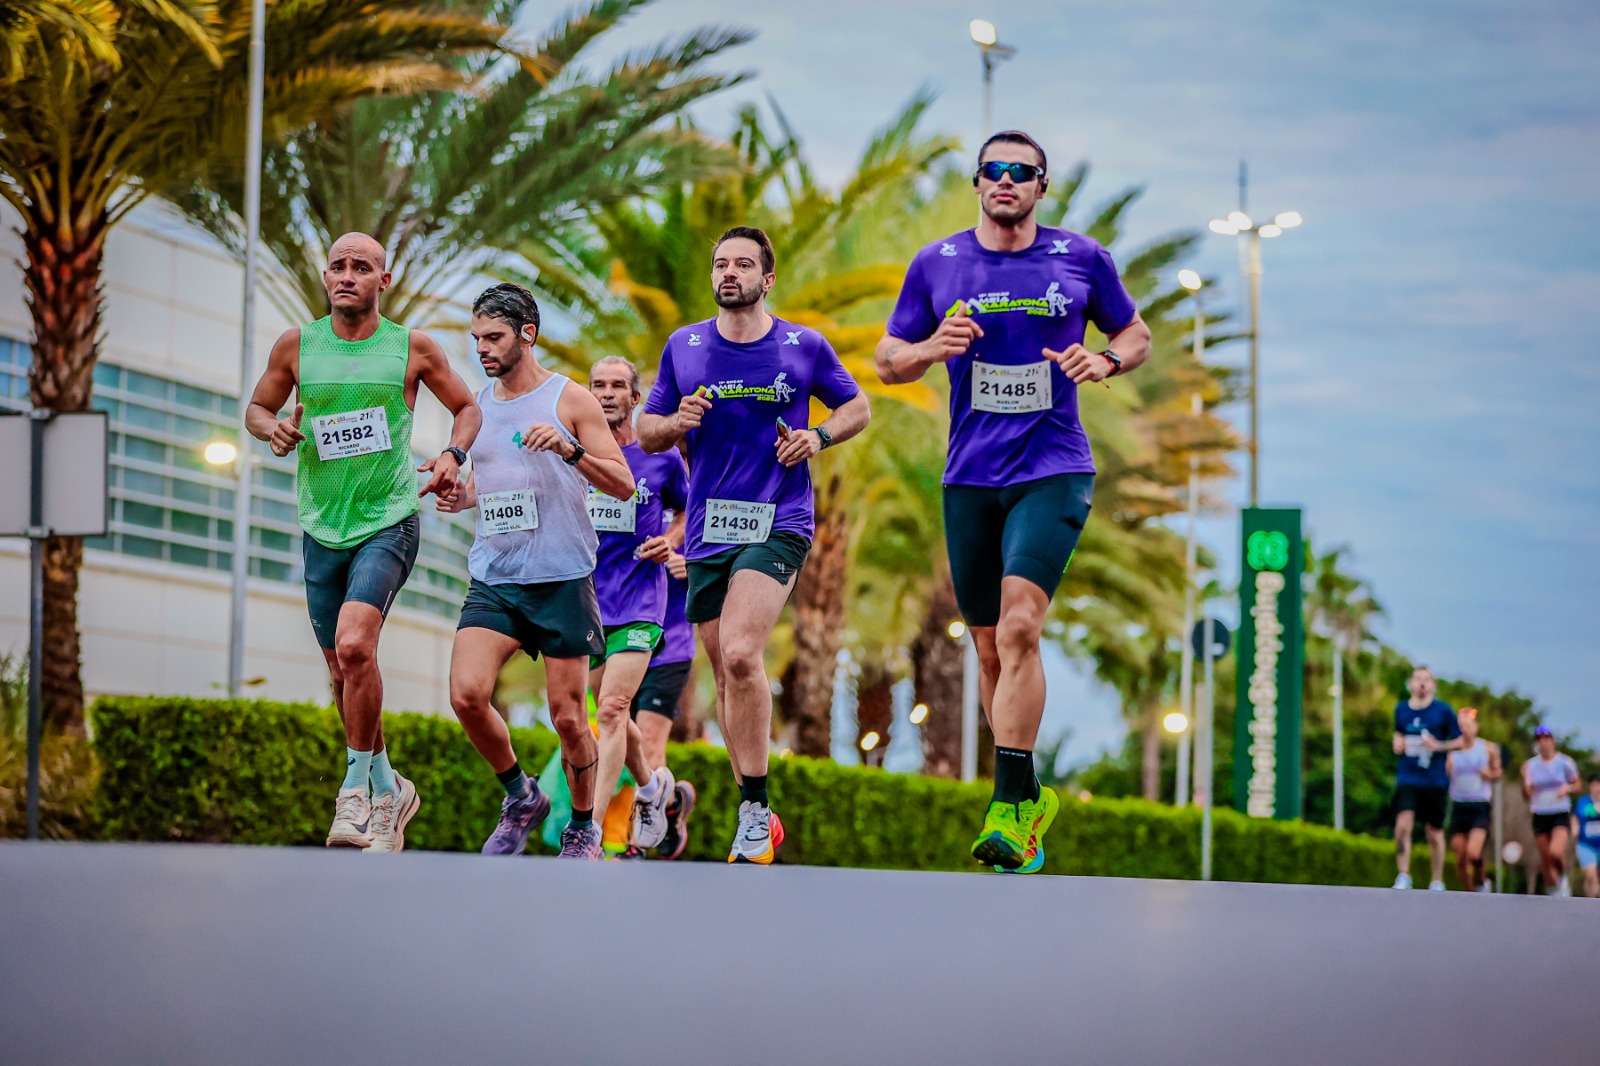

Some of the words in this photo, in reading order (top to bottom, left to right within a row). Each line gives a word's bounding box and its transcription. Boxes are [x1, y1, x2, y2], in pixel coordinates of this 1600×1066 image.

[980, 298, 1048, 309] MARATONA
[719, 387, 775, 395] MARATONA
[980, 381, 1036, 397] 21485
[322, 425, 374, 445] 21582
[484, 505, 523, 521] 21408
[589, 508, 621, 518] 1786
[710, 516, 758, 530] 21430
